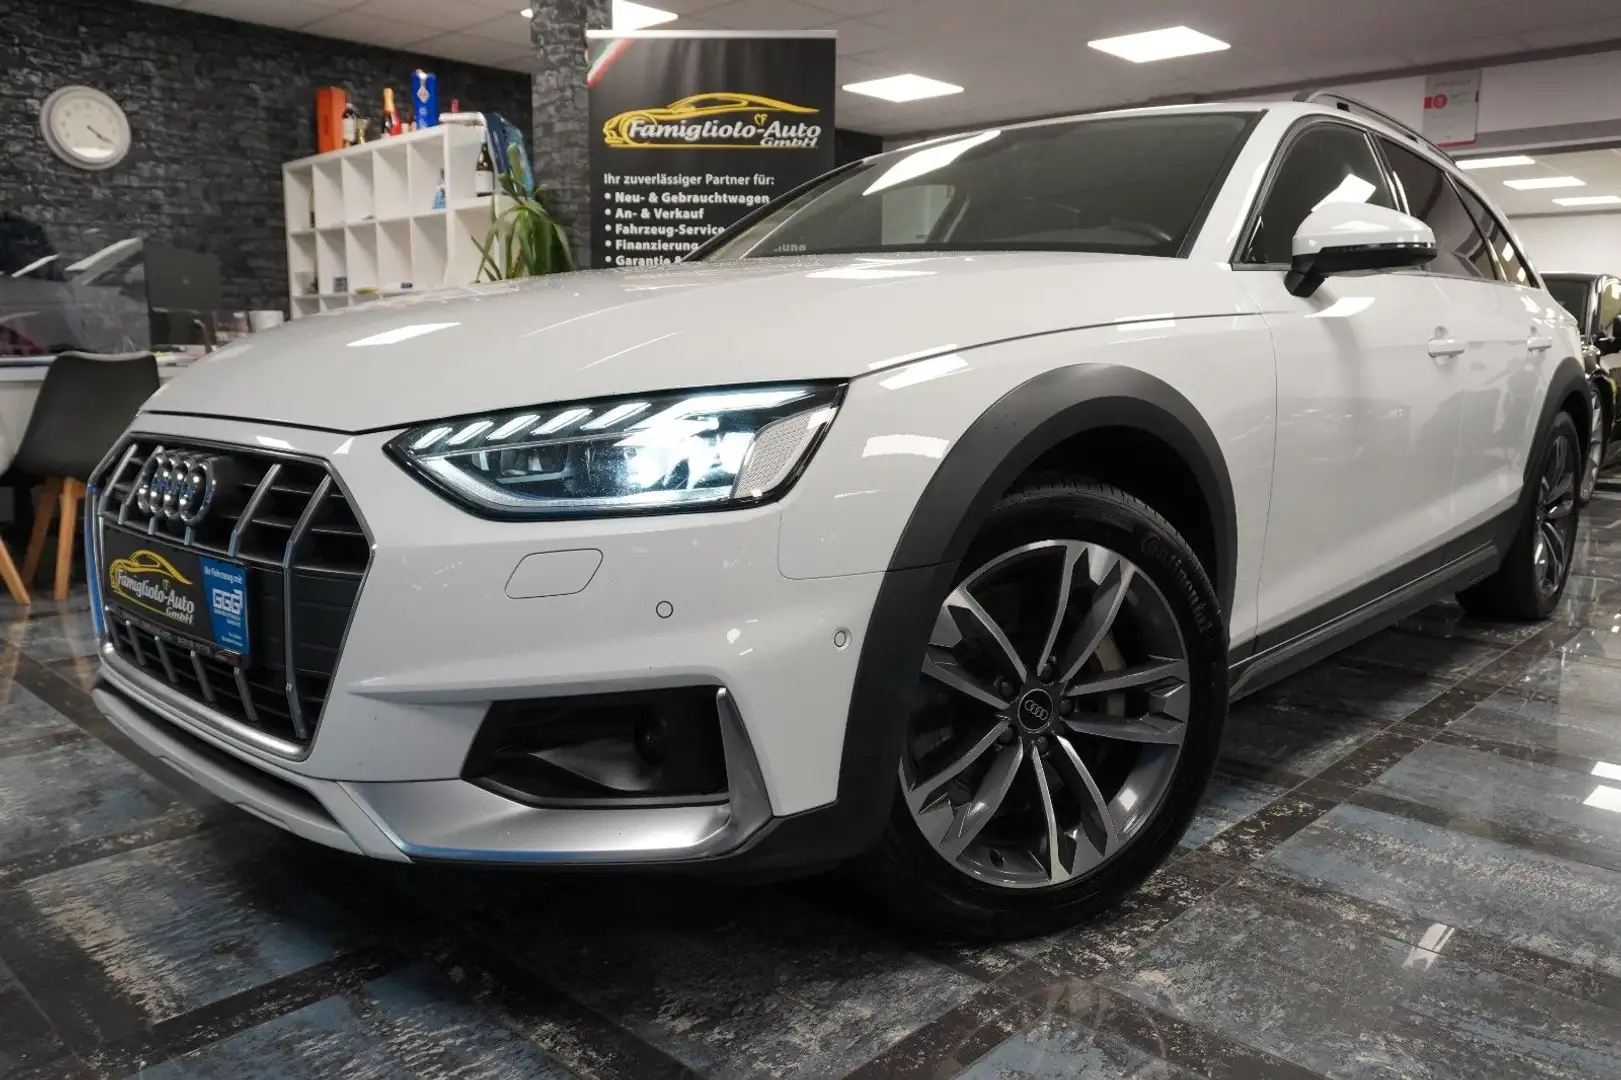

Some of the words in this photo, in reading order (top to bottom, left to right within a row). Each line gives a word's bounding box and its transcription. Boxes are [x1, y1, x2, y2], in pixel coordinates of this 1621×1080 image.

[629, 120, 822, 141] Famigliolo-Auto
[760, 137, 818, 148] GmbH
[604, 174, 620, 185] Ihr
[623, 173, 701, 187] zuverlässiger
[705, 174, 751, 185] Partner
[753, 174, 775, 185] für:
[615, 193, 645, 203] Neu-
[648, 193, 658, 203] &
[661, 192, 770, 206] Gebrauchtwagen
[615, 209, 637, 219] An-
[641, 209, 650, 219] &
[654, 208, 704, 219] Verkauf
[615, 224, 725, 237] Fahrzeug-Service
[118, 569, 195, 614] Famigliolo-Auto
[165, 607, 194, 625] GmbH
